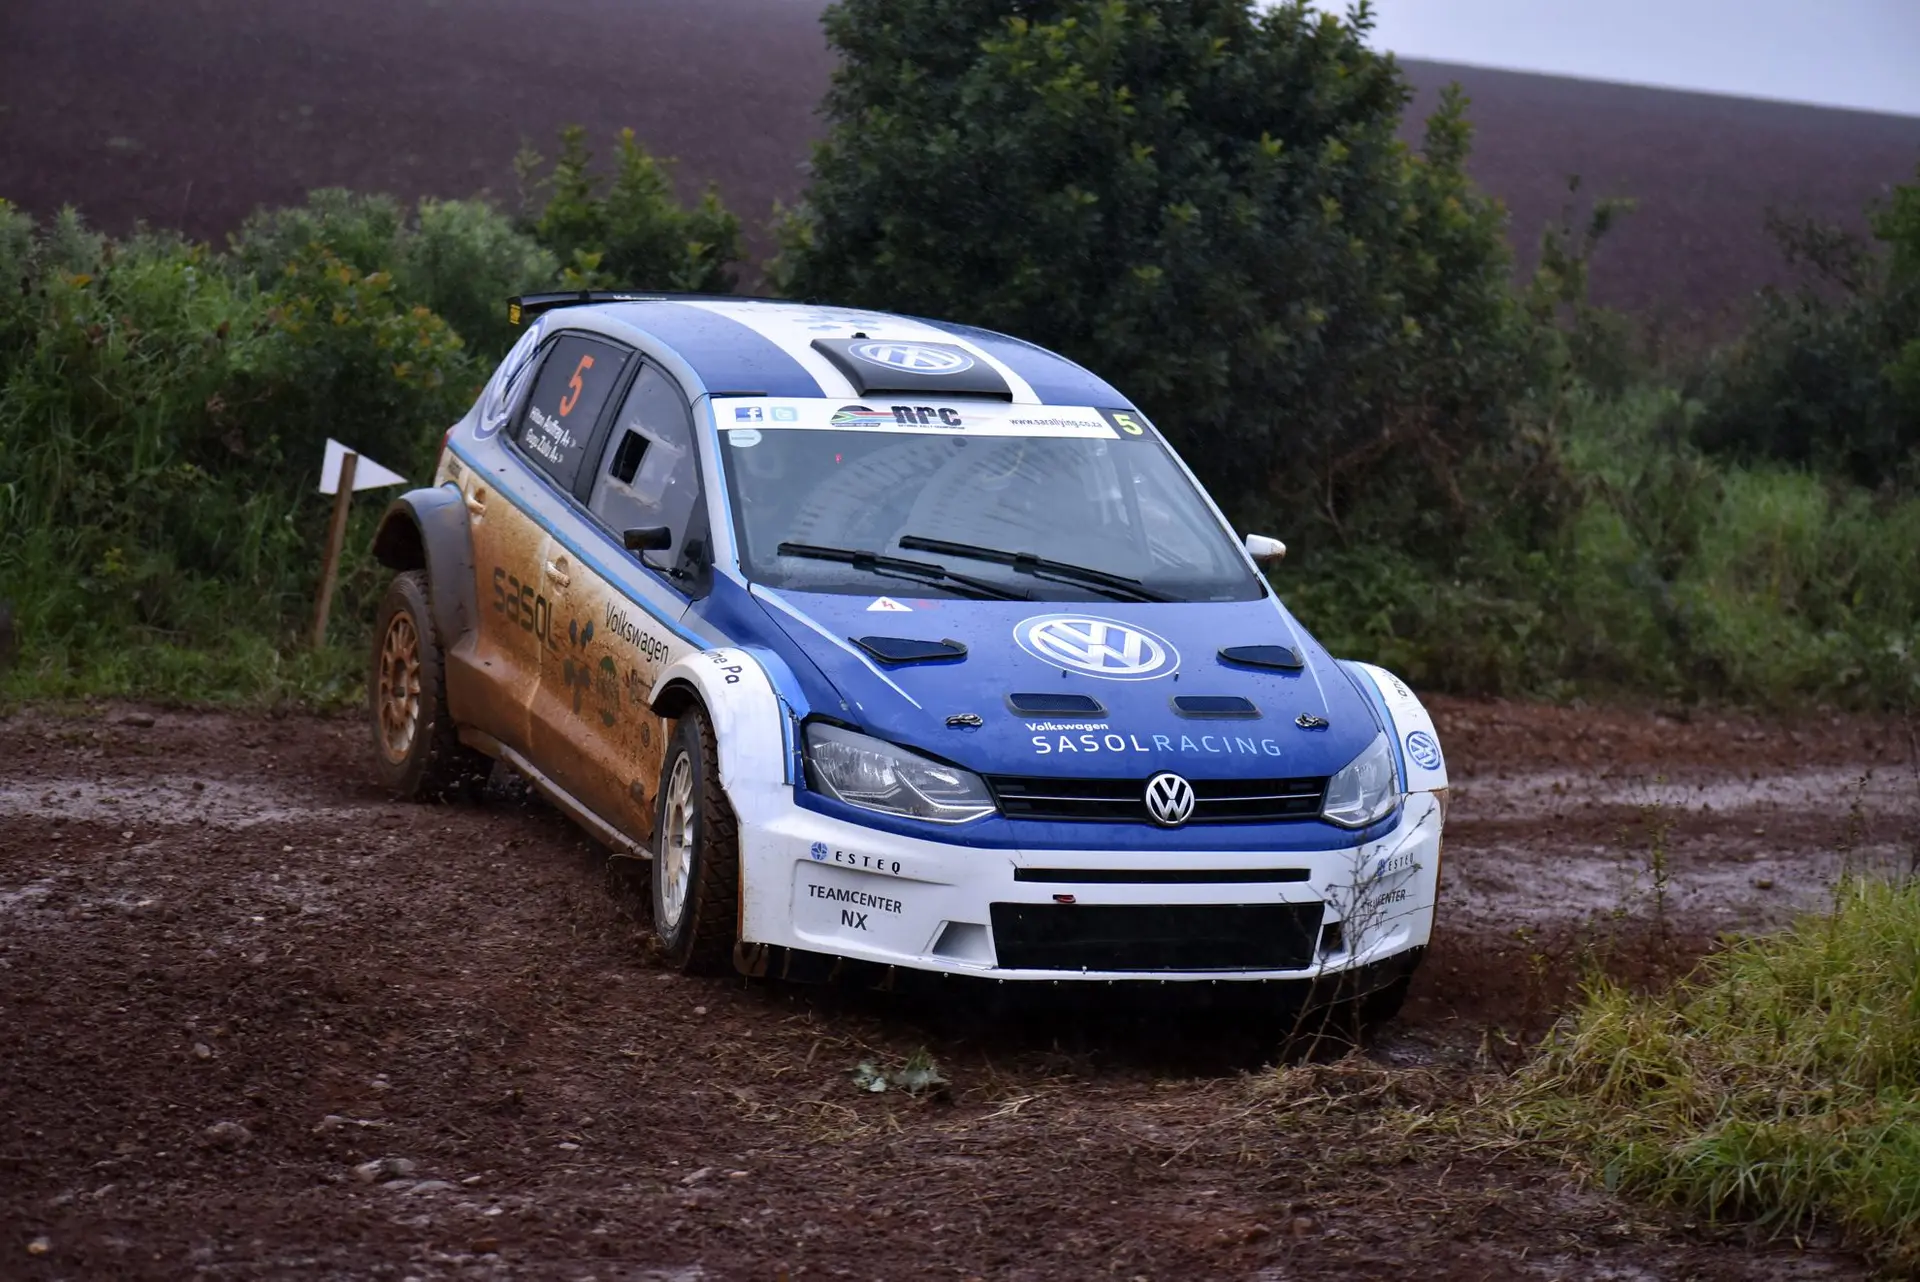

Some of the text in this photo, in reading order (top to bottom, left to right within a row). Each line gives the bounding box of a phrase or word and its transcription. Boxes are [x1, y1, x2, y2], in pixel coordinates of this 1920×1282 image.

[559, 355, 595, 417] 5
[1113, 413, 1144, 436] 5
[605, 600, 669, 664] Volkswagen
[1025, 722, 1109, 732] Volkswagen
[1145, 773, 1196, 826] VW
[836, 851, 901, 875] ESTEQ
[808, 884, 902, 914] TEAMCENTER
[841, 909, 868, 931] NX
